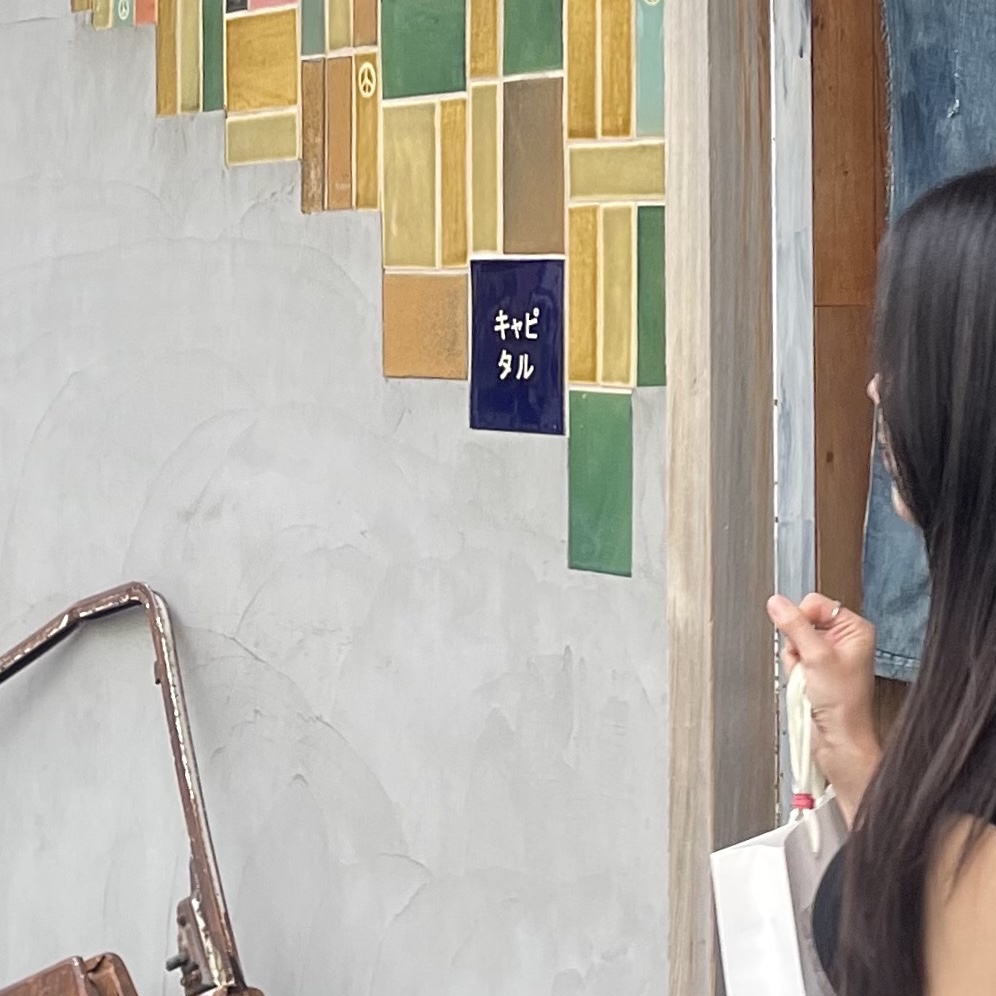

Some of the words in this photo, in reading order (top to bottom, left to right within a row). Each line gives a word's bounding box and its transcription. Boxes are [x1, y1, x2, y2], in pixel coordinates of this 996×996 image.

[494, 307, 540, 341] キャピ
[498, 349, 535, 381] タル
